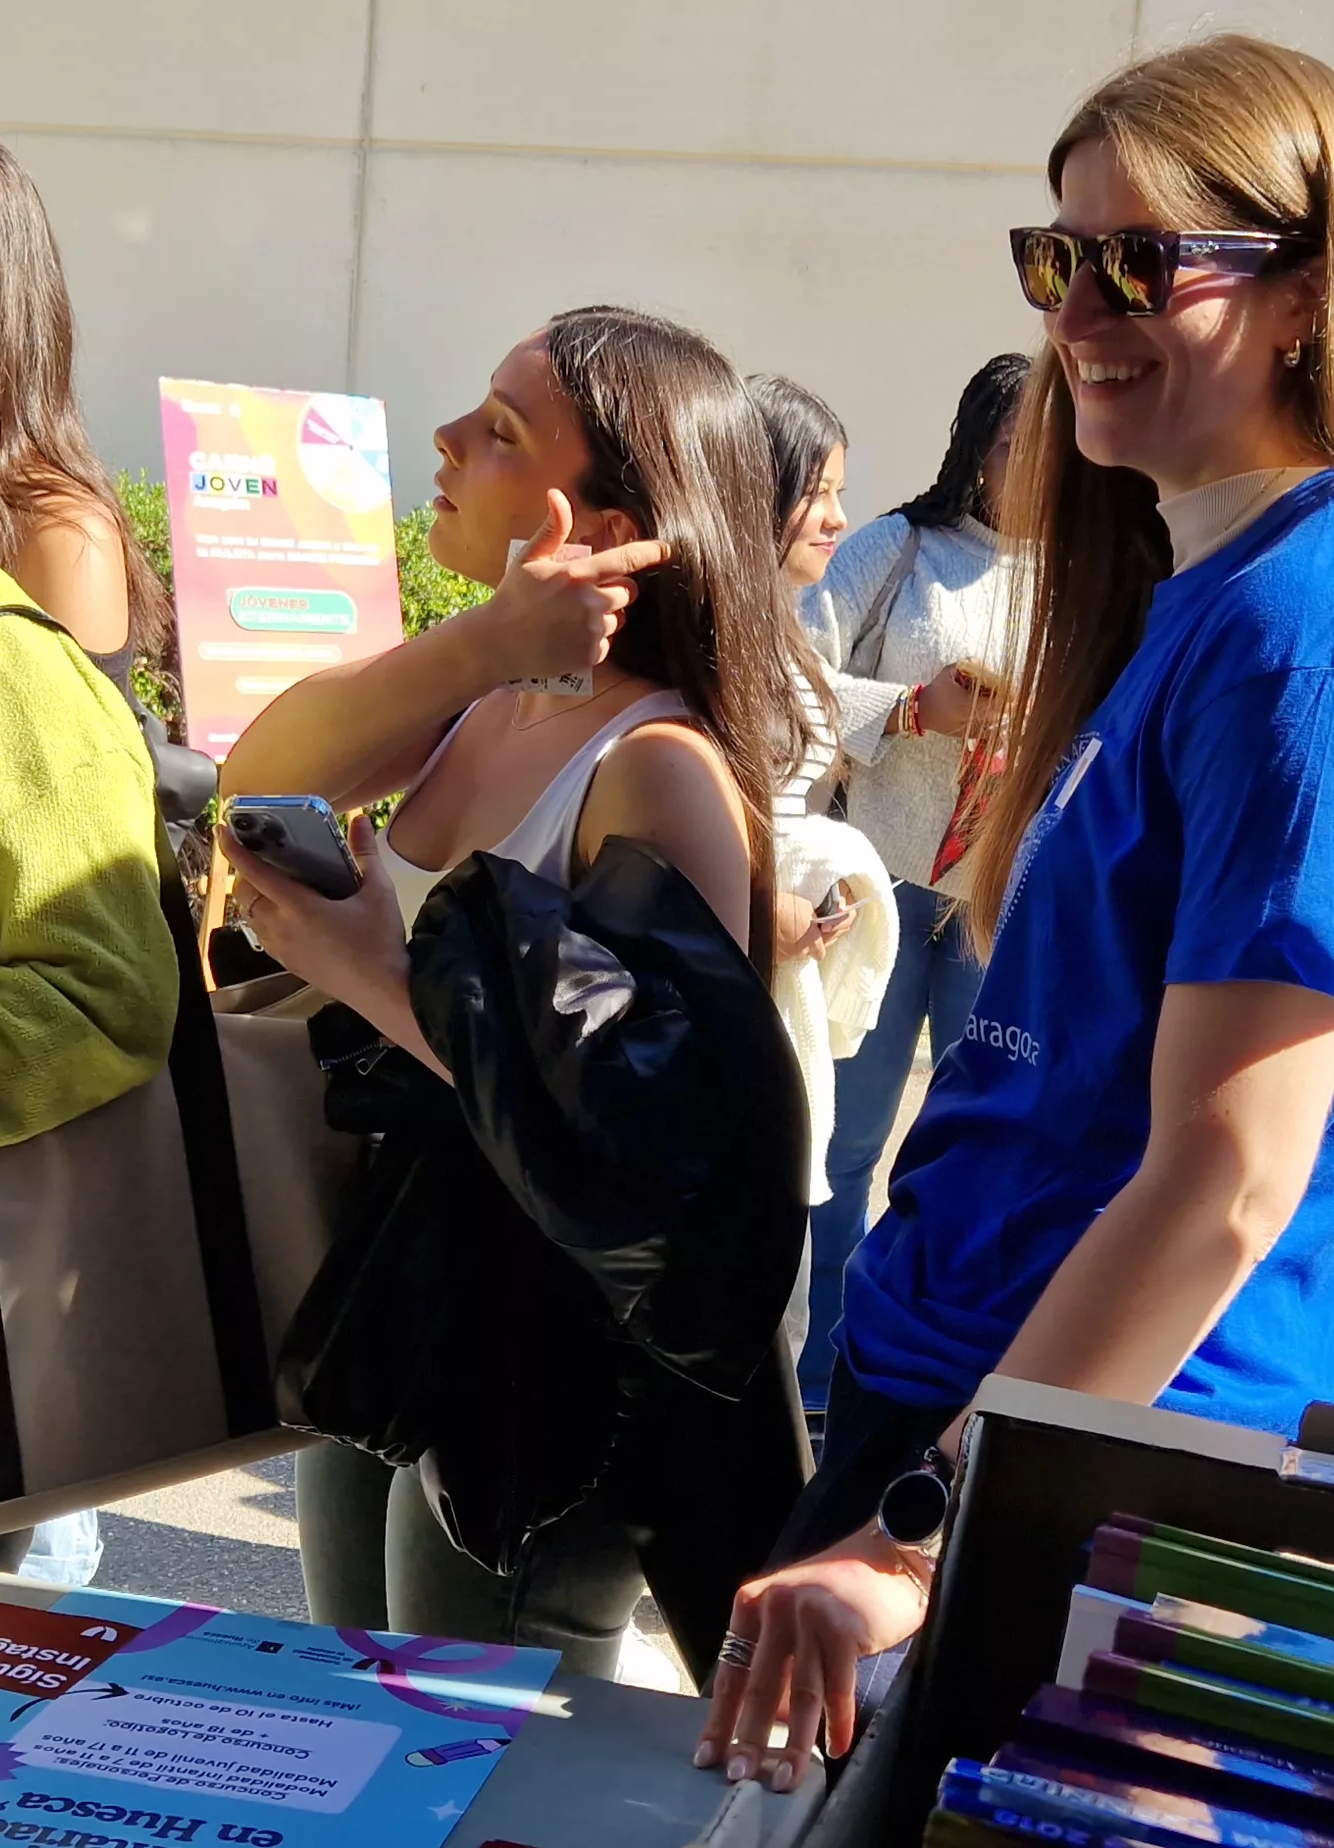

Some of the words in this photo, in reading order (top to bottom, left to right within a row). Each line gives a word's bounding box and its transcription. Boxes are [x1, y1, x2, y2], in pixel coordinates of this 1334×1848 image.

[192, 473, 278, 497] JOVEN
[239, 593, 308, 609] JÓVENES
[132, 1693, 205, 1711] octubre
[266, 1691, 286, 1700] en
[288, 1695, 321, 1706] info
[208, 1705, 232, 1714] de
[258, 1711, 276, 1719] el
[161, 1718, 205, 1730] años
[280, 1714, 334, 1728] Hasta
[207, 1725, 226, 1734] 18
[230, 1728, 255, 1737] de
[40, 1734, 86, 1747] años
[192, 1732, 218, 1742] de
[33, 1744, 78, 1758] años
[87, 1742, 107, 1751] 17
[222, 1737, 313, 1760] Concurso
[143, 1750, 169, 1760] de
[128, 1760, 153, 1770] de
[170, 1753, 238, 1771] juvenil
[155, 1764, 223, 1780] infantil
[234, 1765, 338, 1788] Modalidad
[165, 1776, 190, 1786] de
[225, 1775, 329, 1797] Modalidad
[194, 1780, 290, 1801] Concurso
[216, 1823, 284, 1848] en
